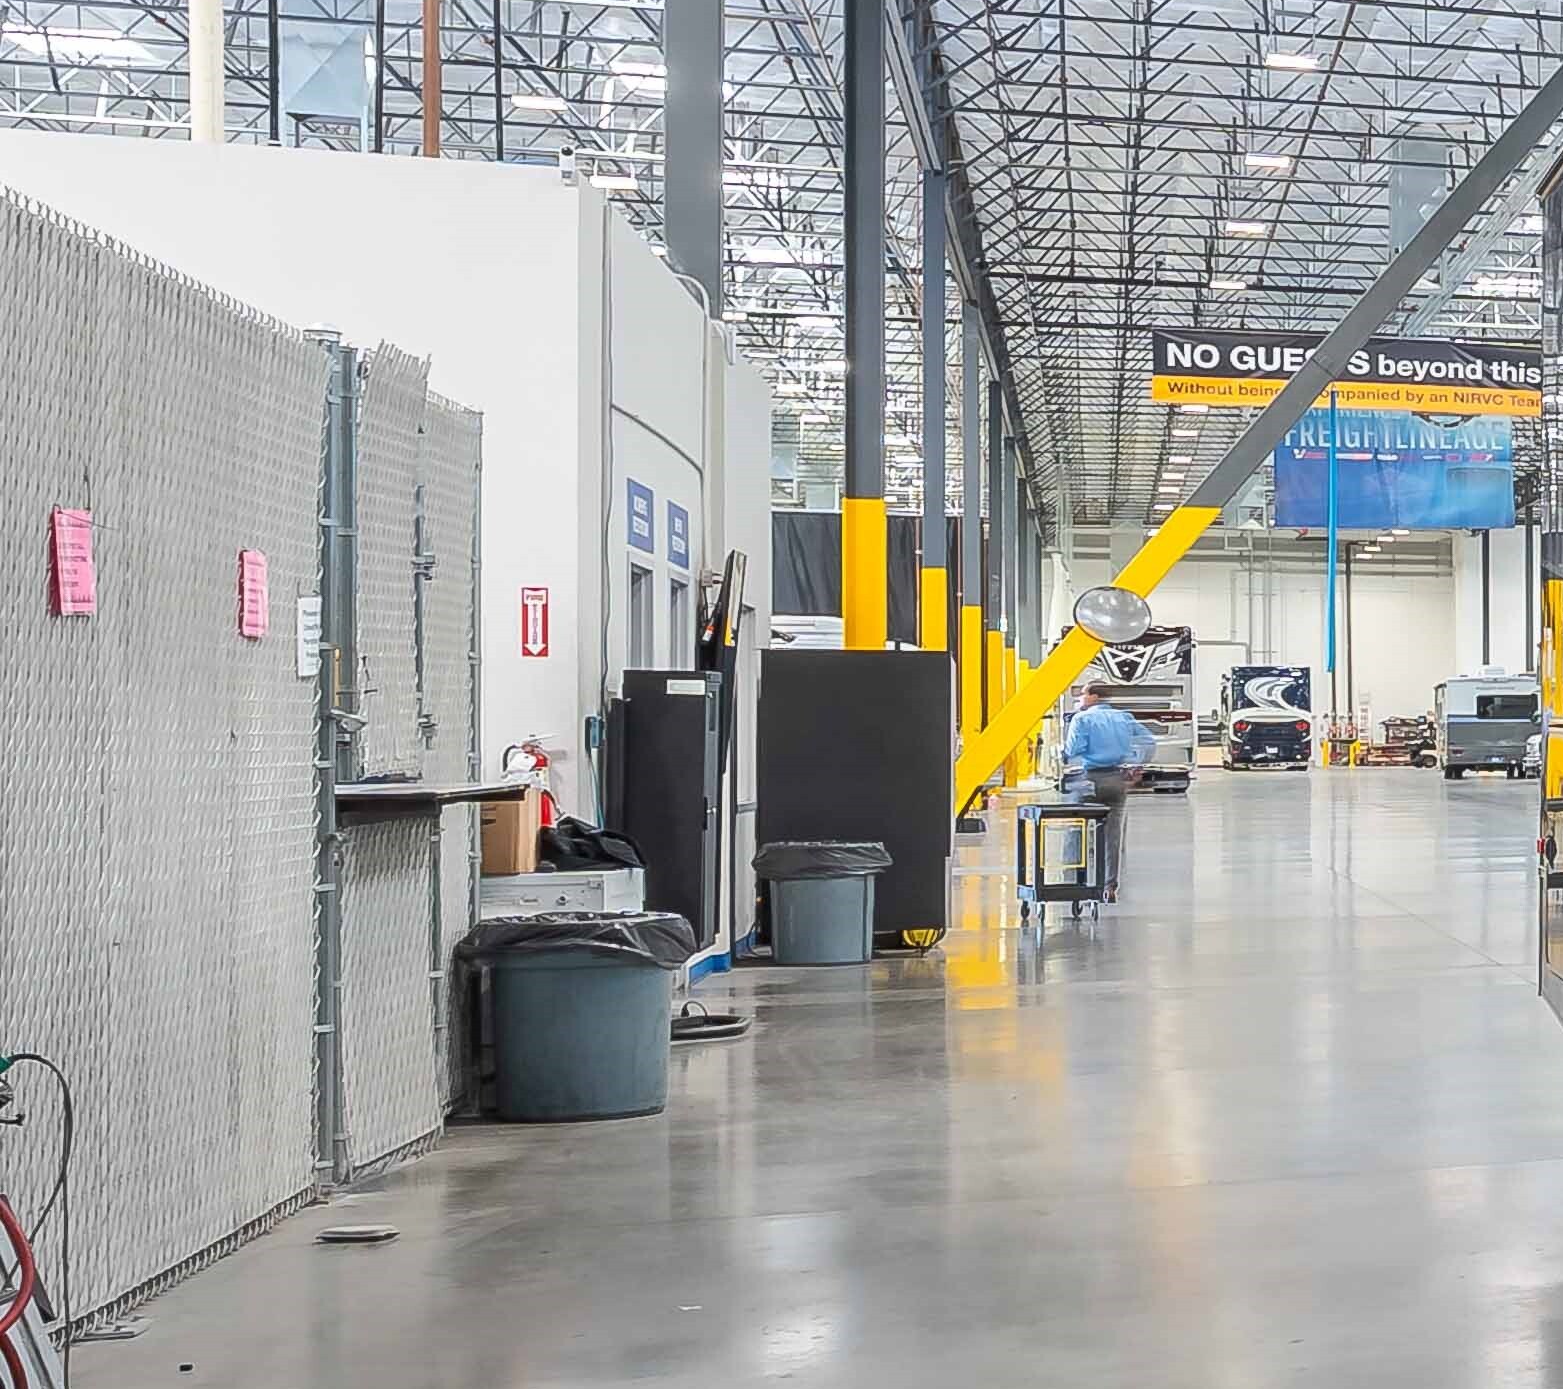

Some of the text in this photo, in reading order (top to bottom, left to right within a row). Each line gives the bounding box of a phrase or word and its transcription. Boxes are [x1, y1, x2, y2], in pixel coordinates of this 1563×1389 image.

[1166, 341, 1541, 385] NO GUES beyond this
[1167, 381, 1234, 396] Without
[1405, 390, 1424, 404] by
[1429, 393, 1449, 402] an
[1453, 391, 1504, 405] NIRVC
